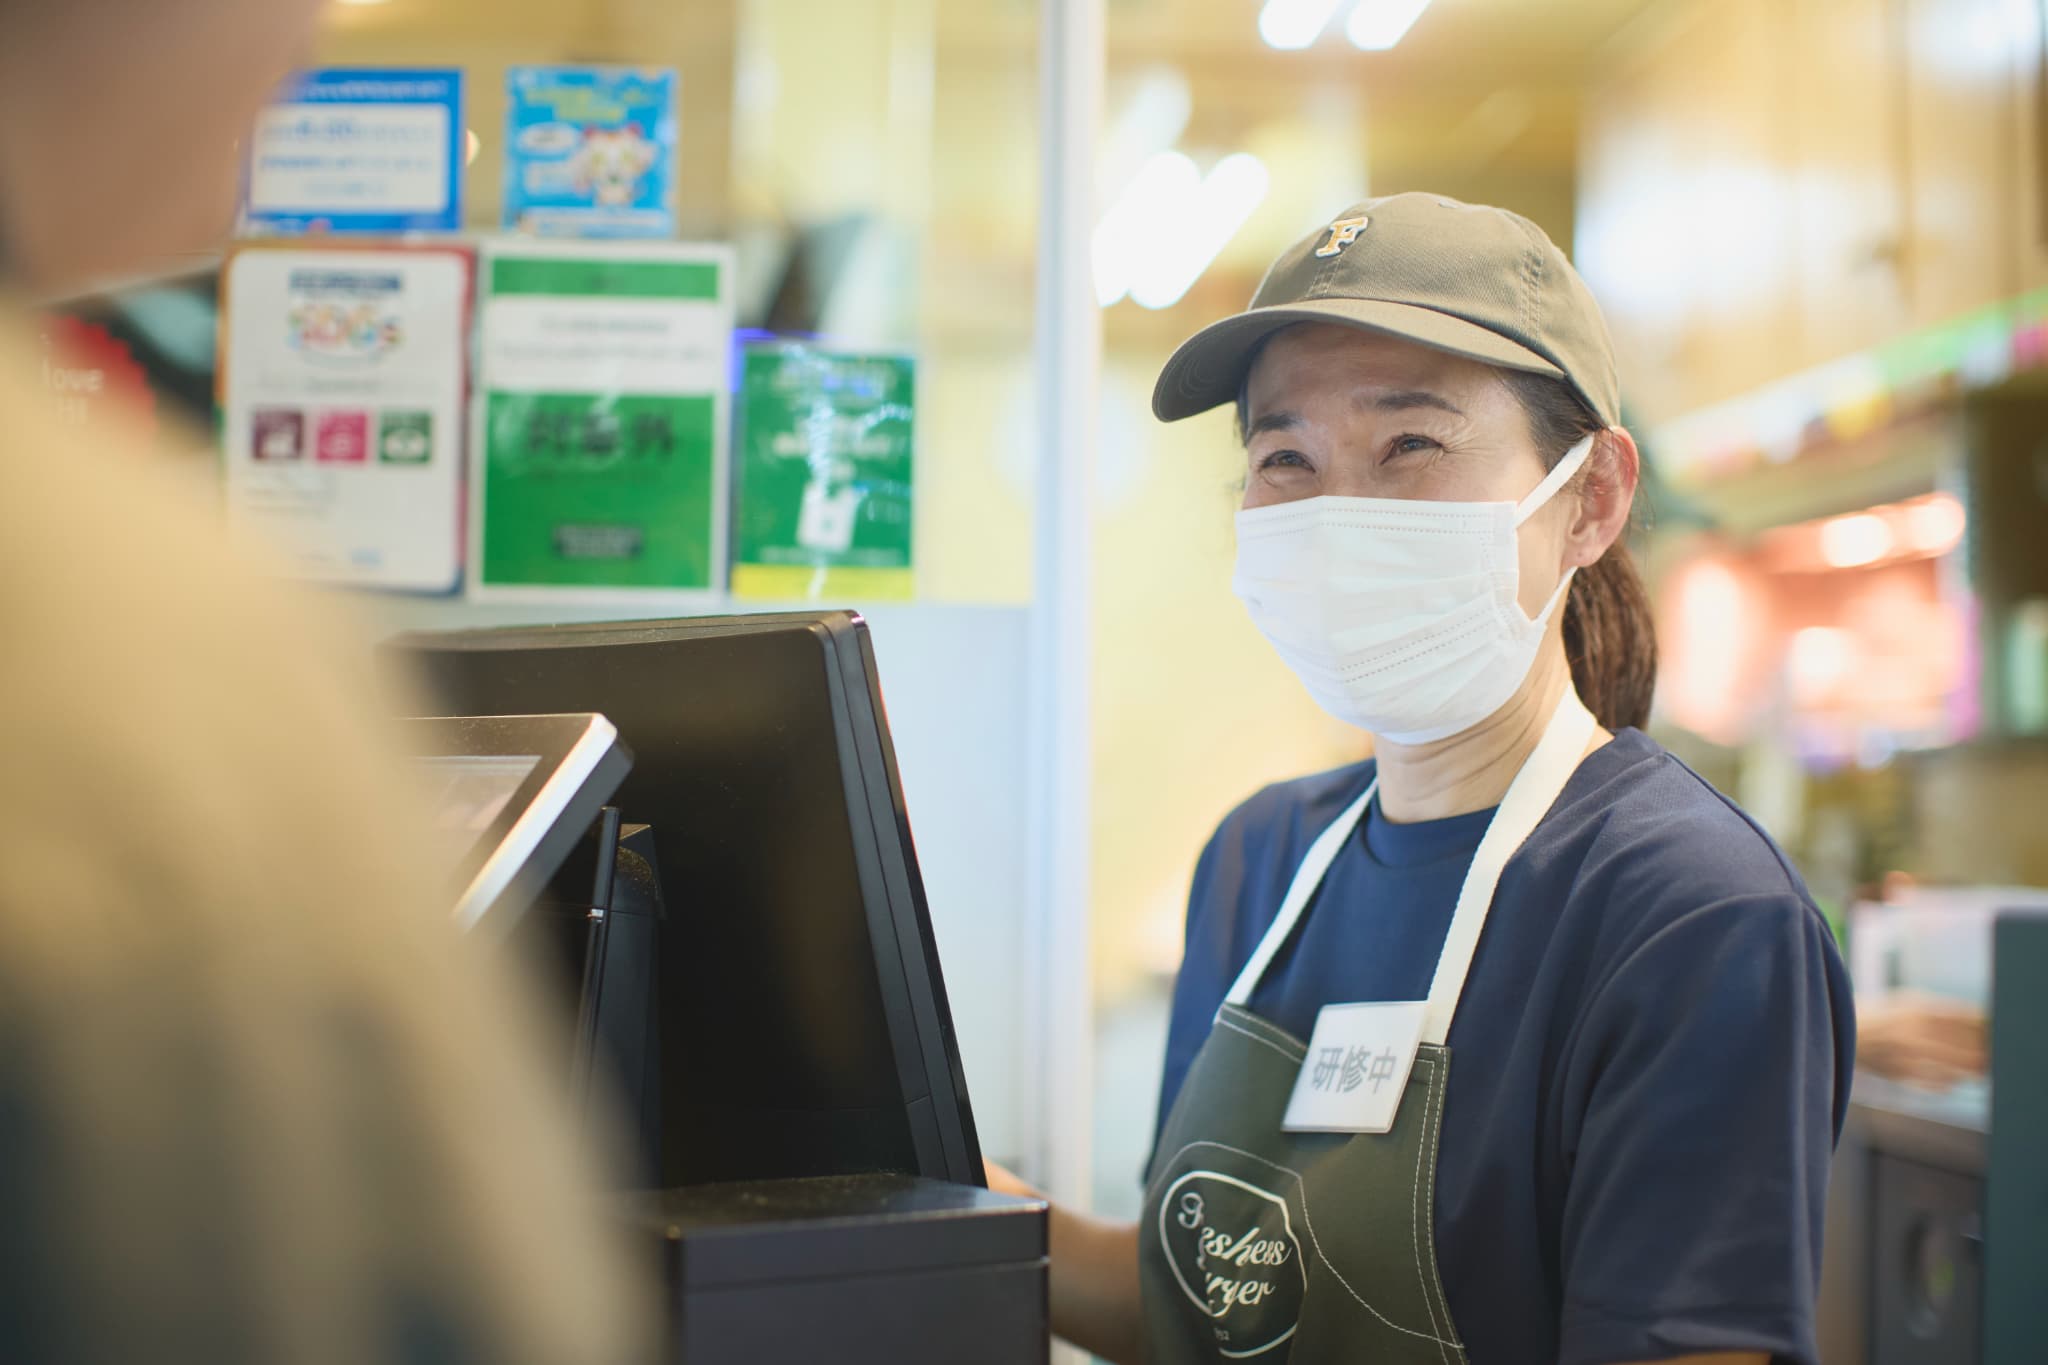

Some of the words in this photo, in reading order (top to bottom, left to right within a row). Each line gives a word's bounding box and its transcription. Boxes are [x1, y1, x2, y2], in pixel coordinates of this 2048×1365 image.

[1315, 216, 1369, 258] F
[1312, 1046, 1397, 1092] 研修中
